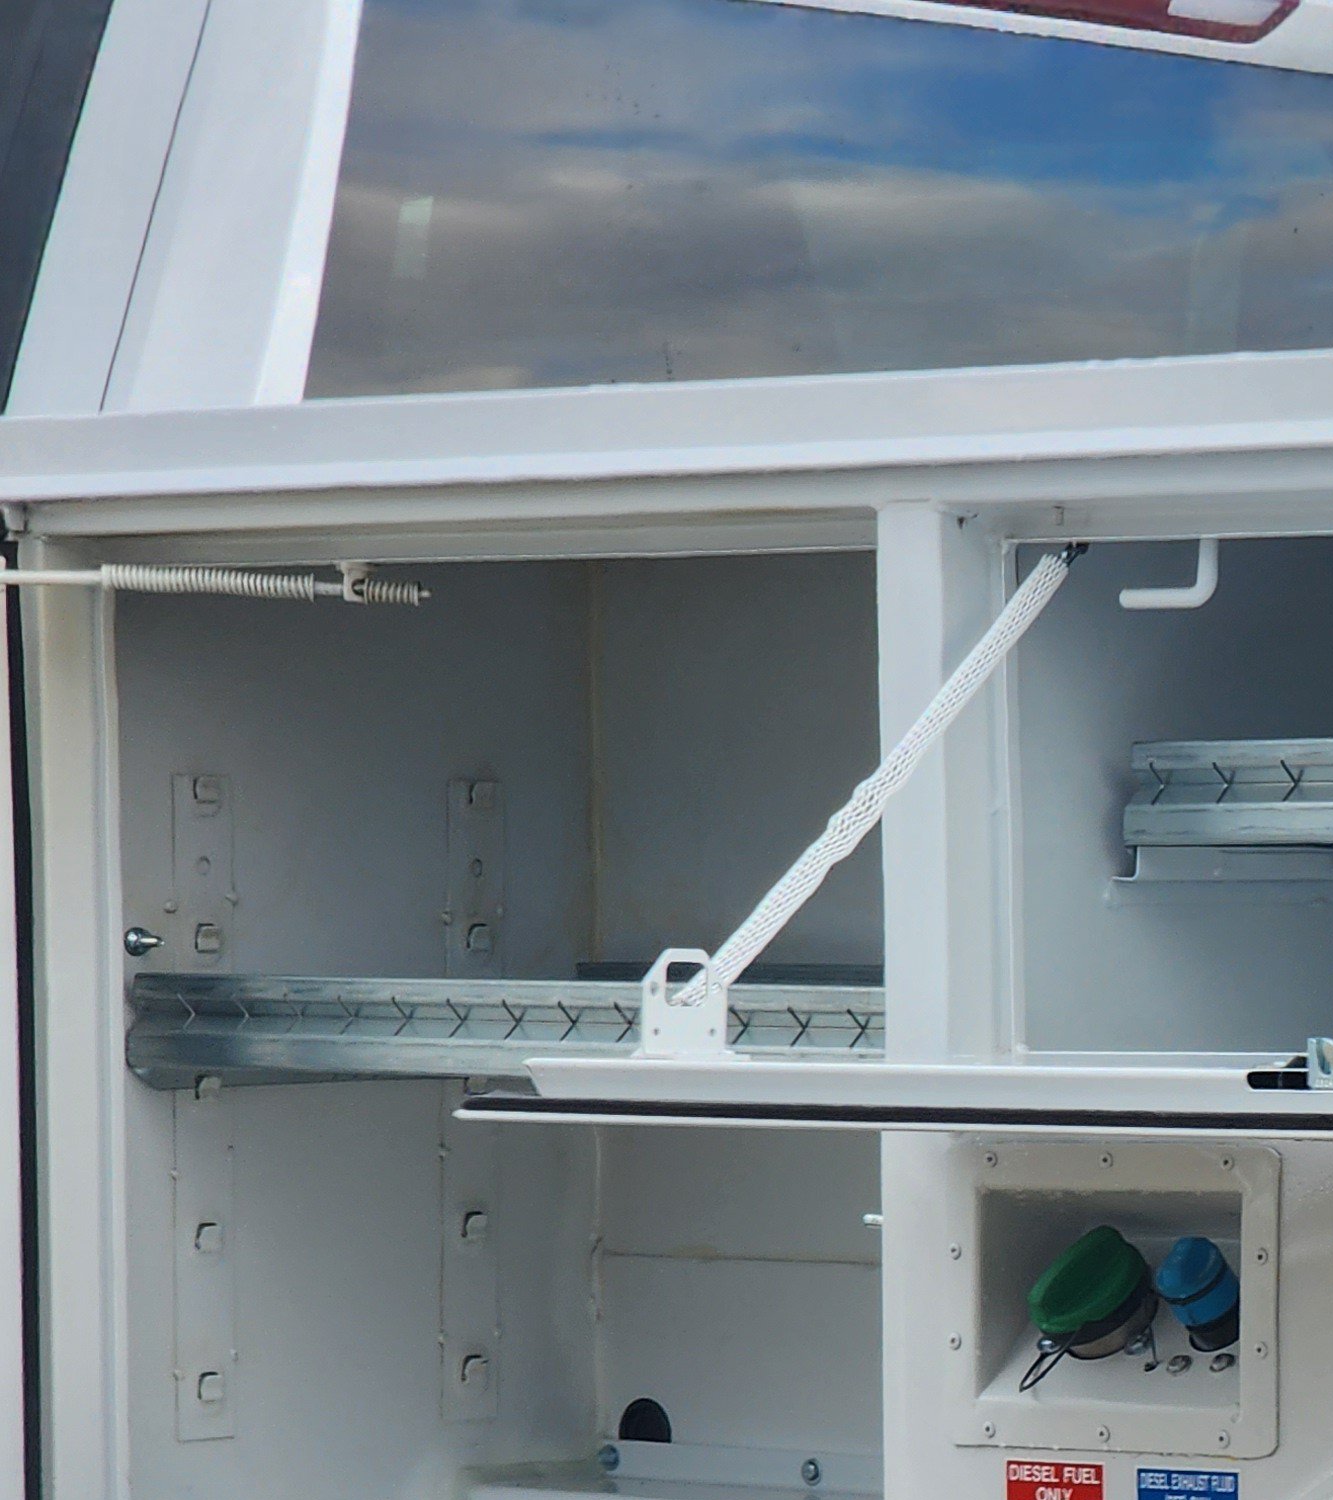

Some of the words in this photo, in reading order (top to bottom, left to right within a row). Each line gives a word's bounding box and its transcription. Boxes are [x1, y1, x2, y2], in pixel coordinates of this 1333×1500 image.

[1008, 1464, 1060, 1483] DIESEL
[1062, 1466, 1101, 1485] FUEL
[1139, 1472, 1170, 1490] DIESEL
[1171, 1473, 1210, 1492] EXHAUST
[1211, 1475, 1236, 1493] FLUID
